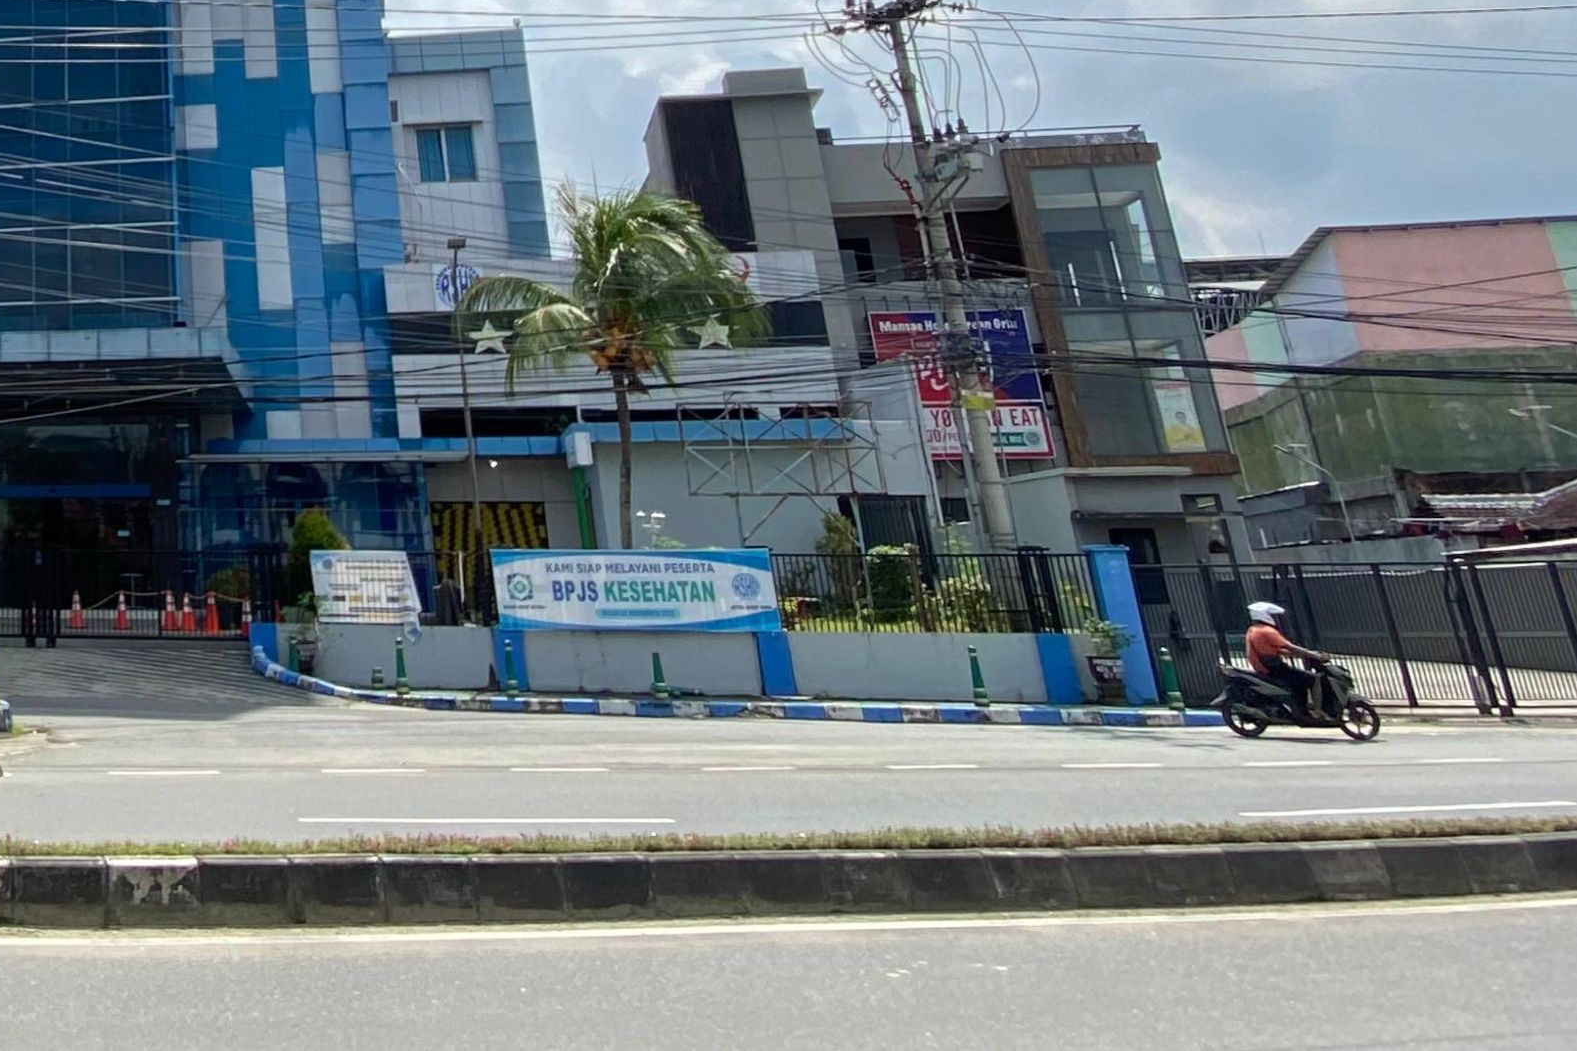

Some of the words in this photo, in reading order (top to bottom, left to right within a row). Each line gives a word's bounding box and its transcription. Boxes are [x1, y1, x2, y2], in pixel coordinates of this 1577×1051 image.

[1010, 409, 1039, 426] EAT
[545, 562, 574, 573] KAMI
[576, 563, 602, 573] SIAP
[604, 563, 662, 573] MELAYANI
[664, 563, 715, 574] PESERTA
[551, 580, 599, 602] BPJS
[603, 580, 715, 603] KESEHATAN
